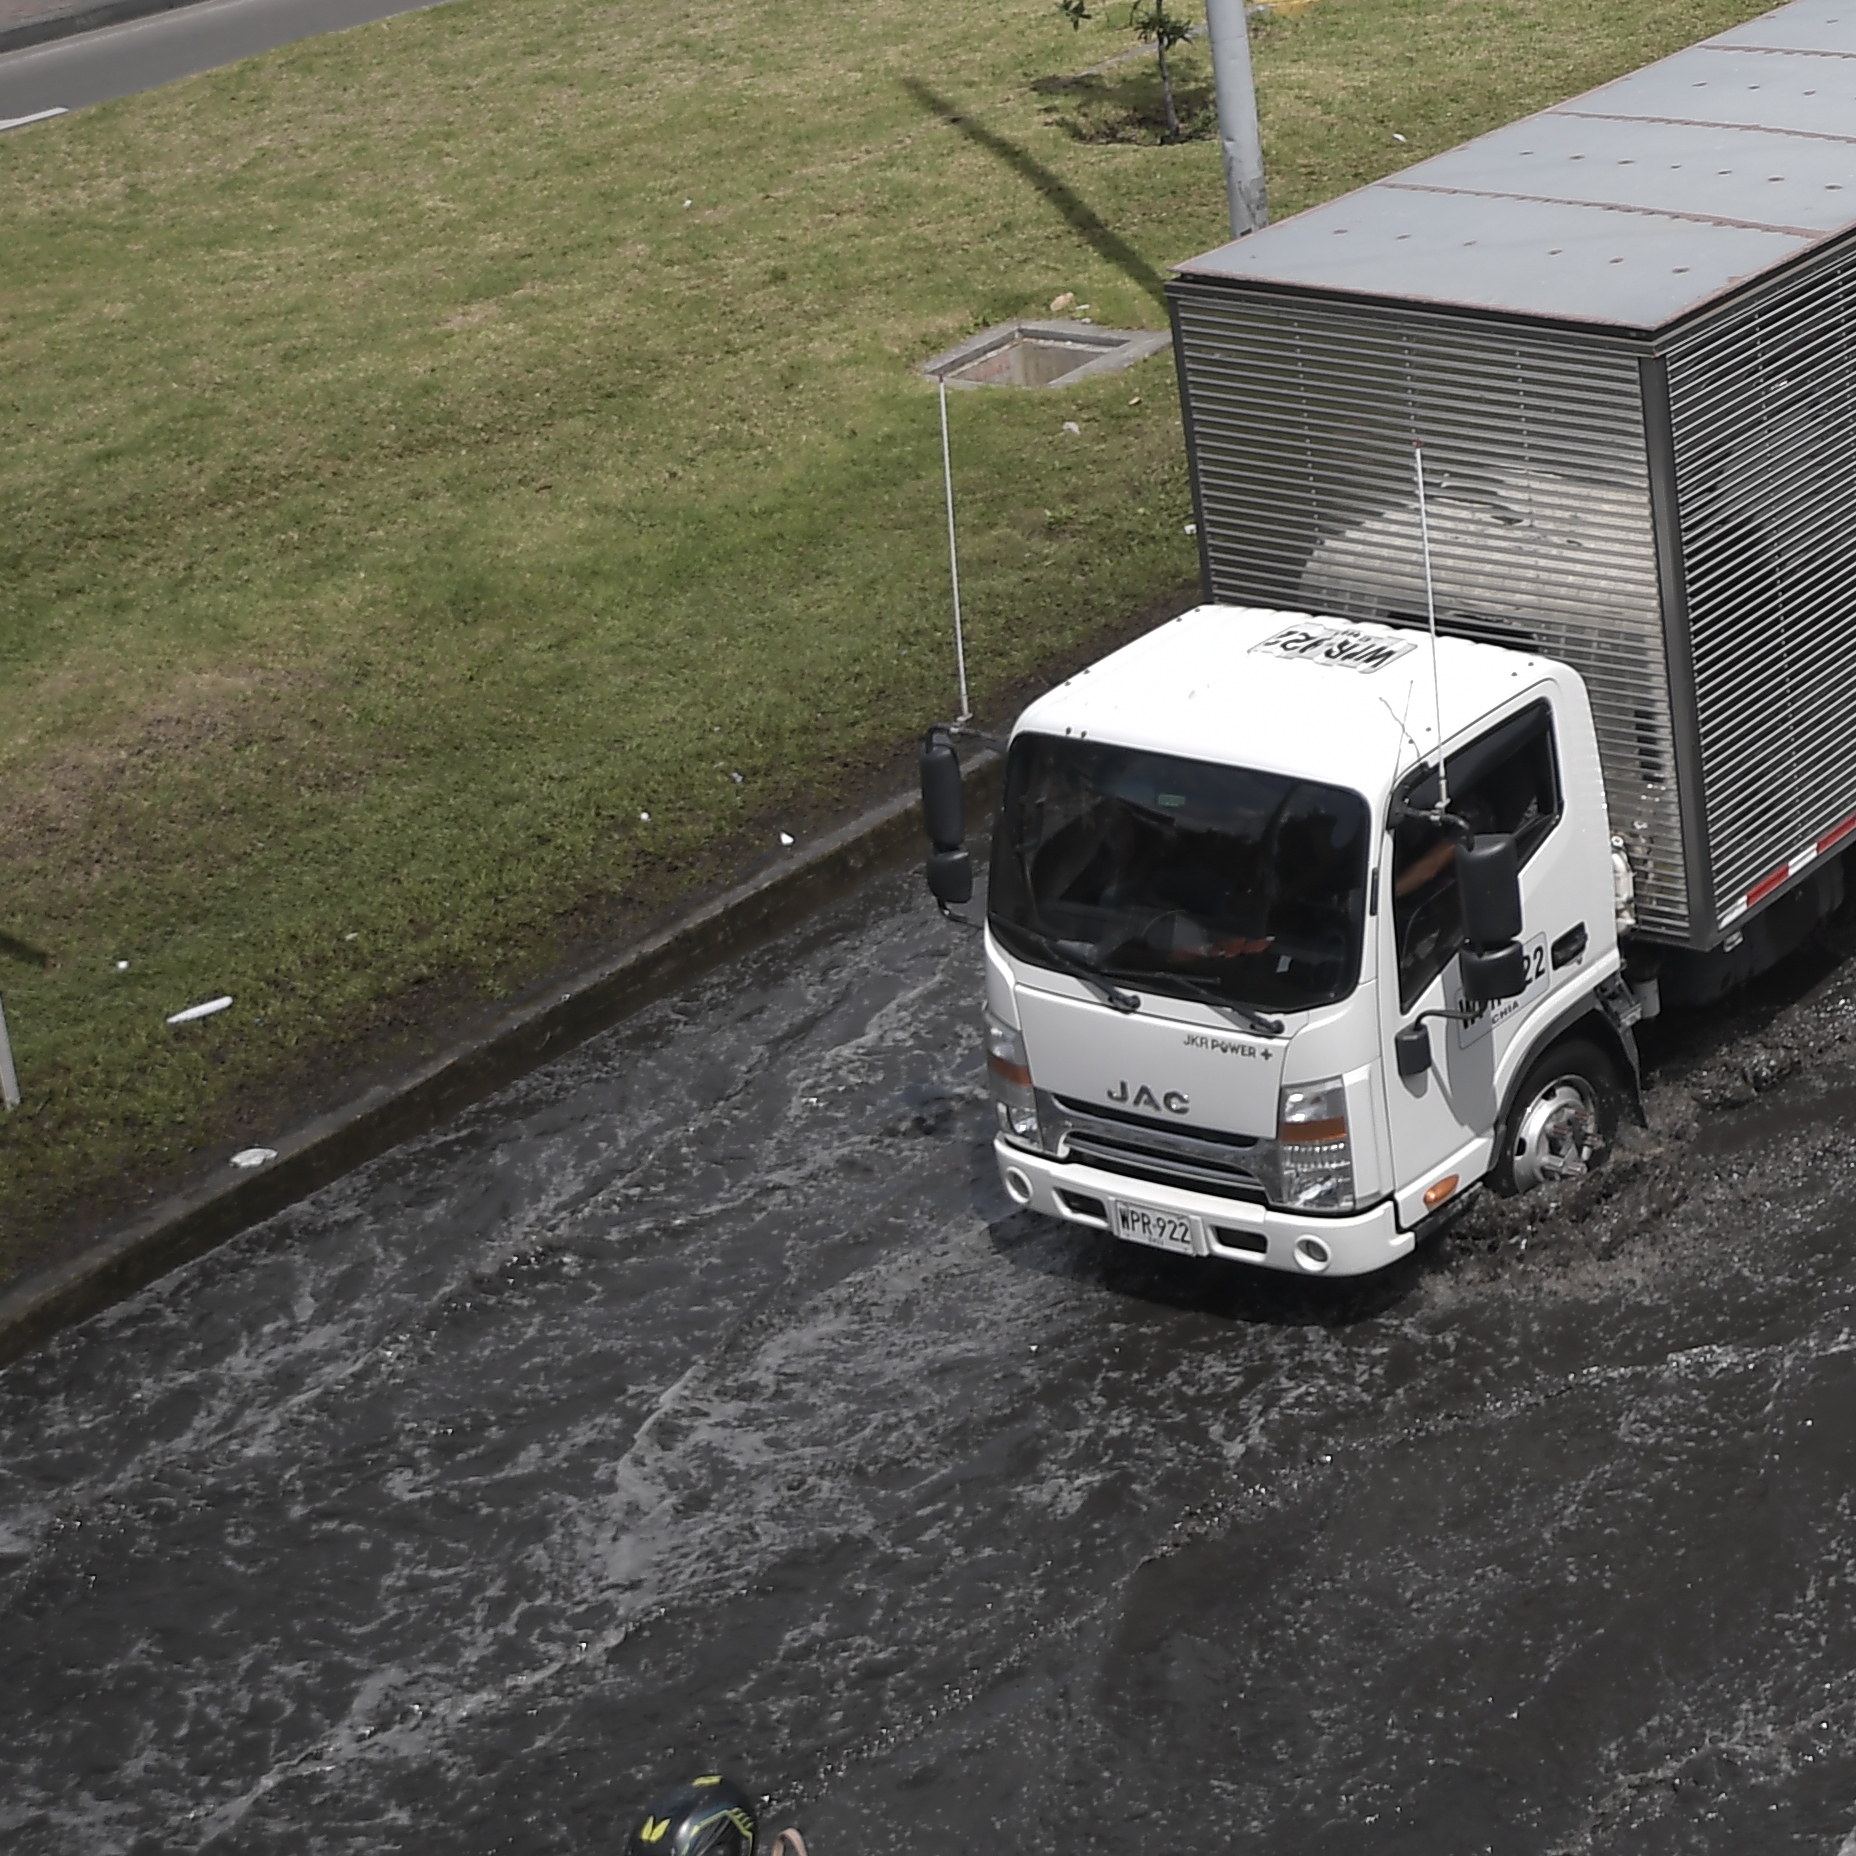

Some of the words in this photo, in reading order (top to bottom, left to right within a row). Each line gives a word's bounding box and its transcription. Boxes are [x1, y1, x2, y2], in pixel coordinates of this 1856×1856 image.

[1491, 1000, 1520, 1025] CHIA
[1210, 1037, 1257, 1059] POWER
[1106, 1078, 1190, 1115] JAC
